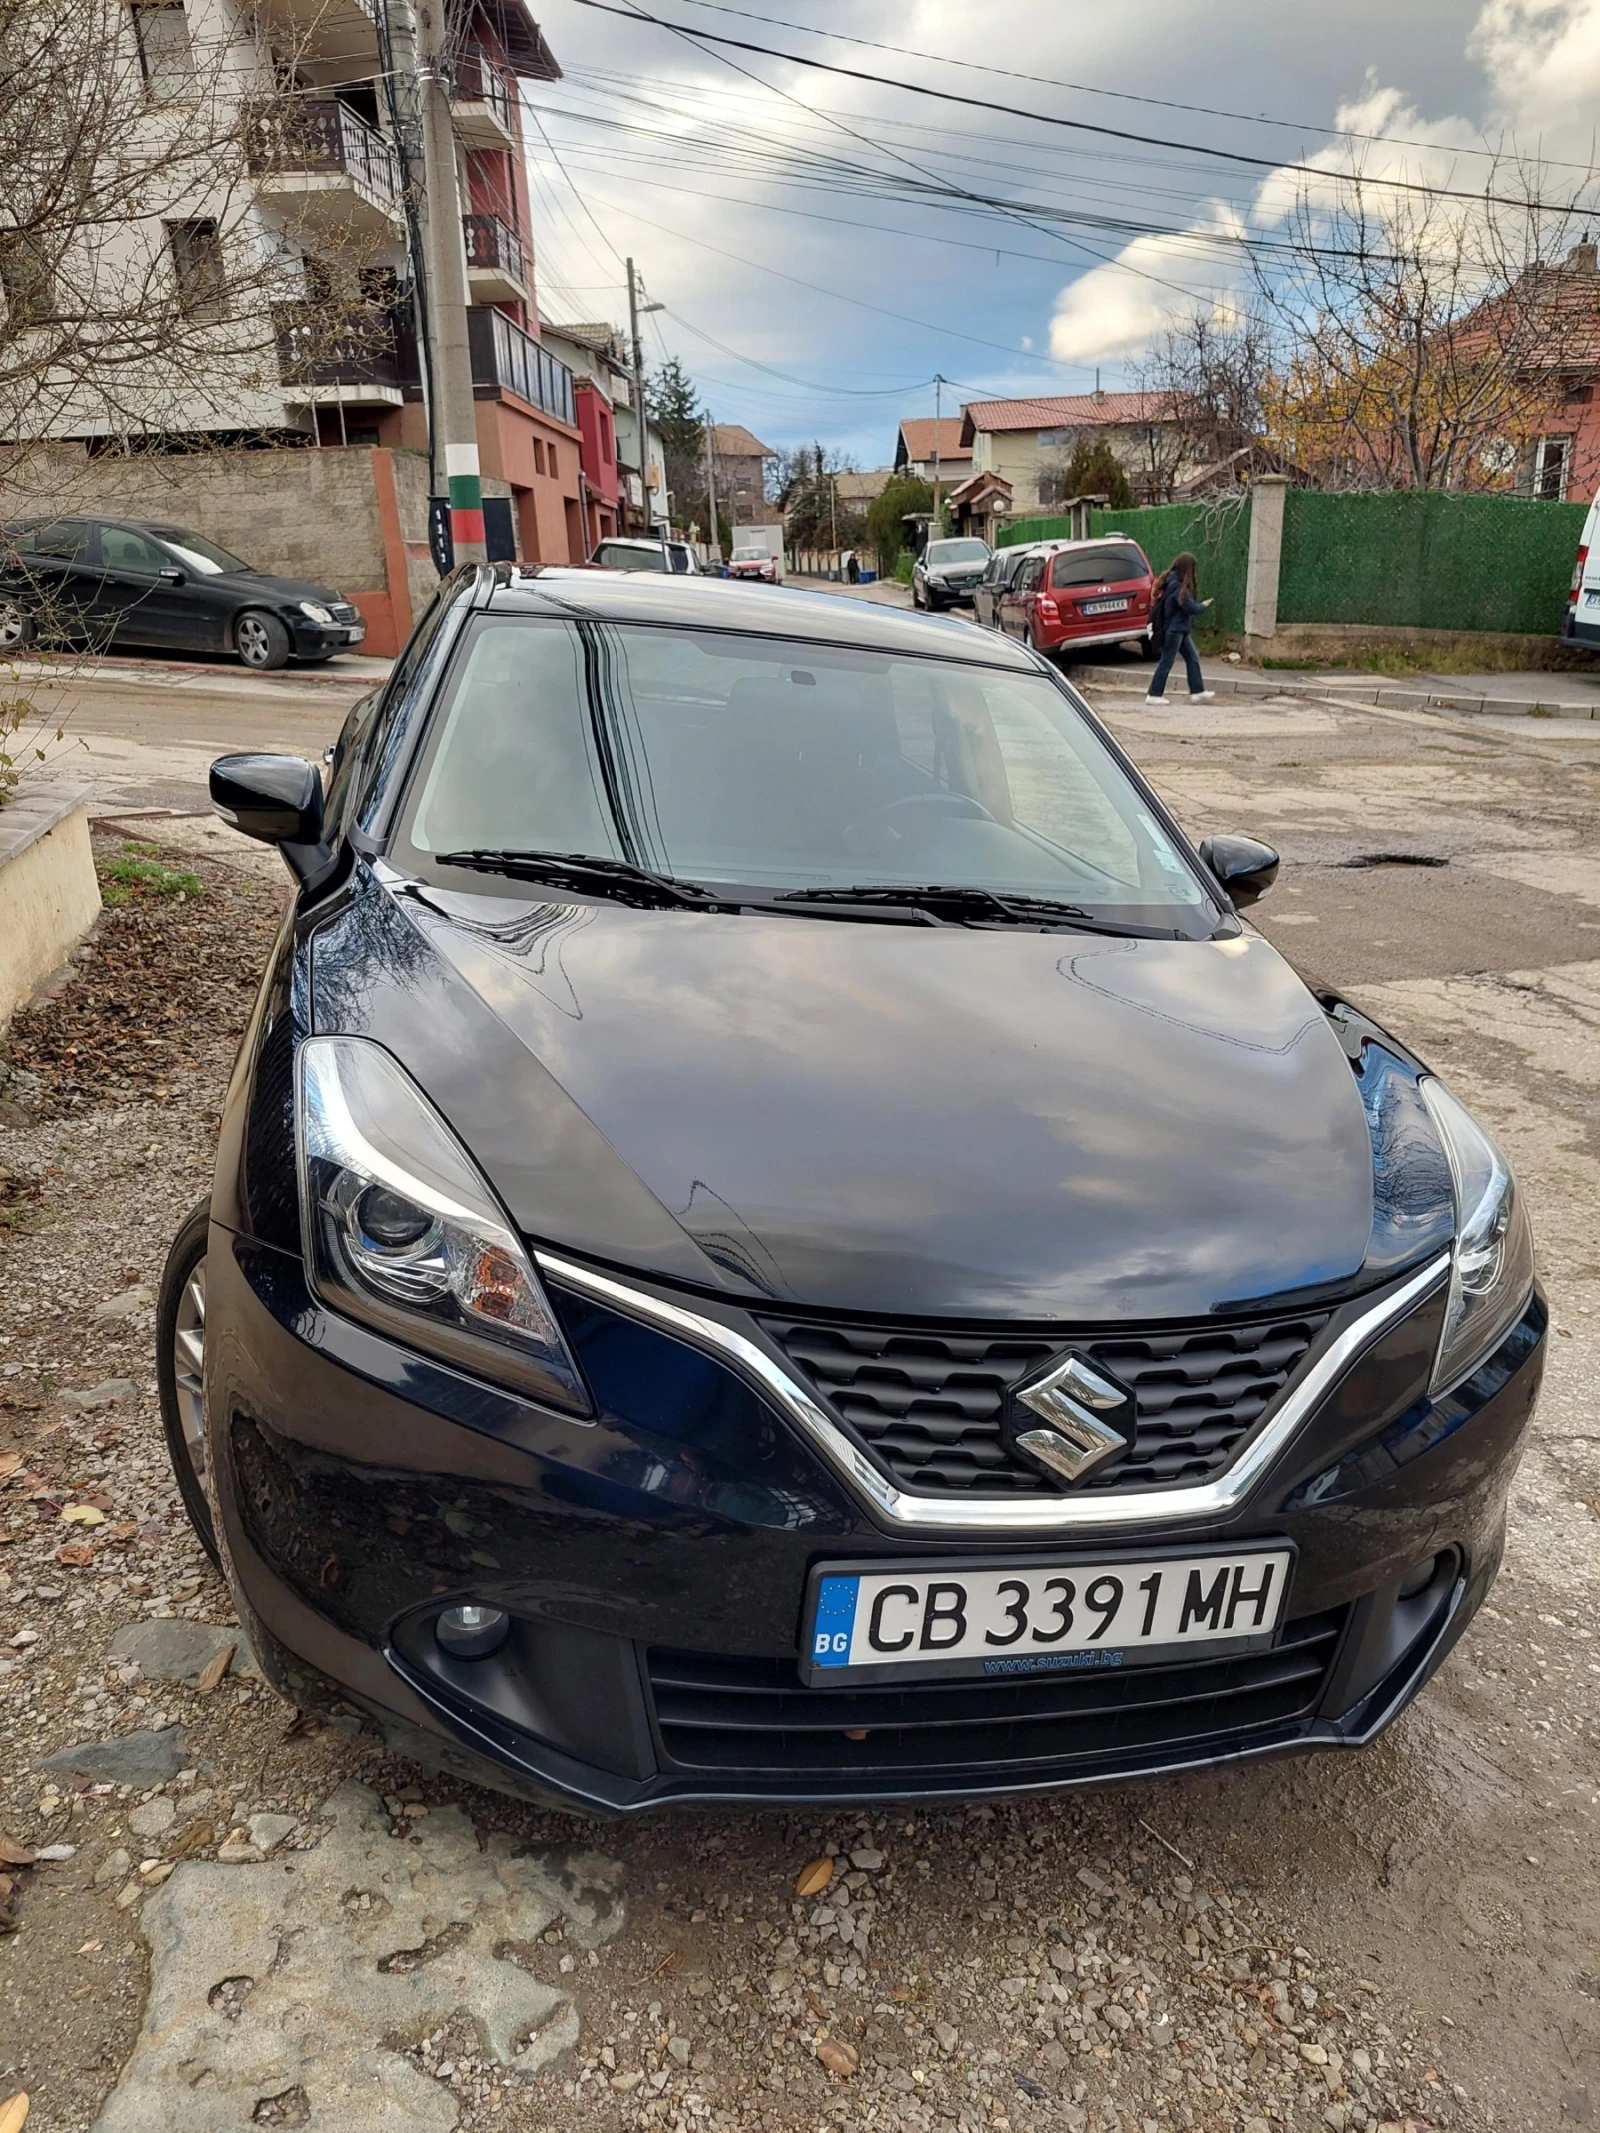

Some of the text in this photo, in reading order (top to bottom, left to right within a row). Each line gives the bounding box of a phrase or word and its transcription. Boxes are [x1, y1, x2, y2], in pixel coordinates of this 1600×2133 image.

[869, 1563, 1275, 1652] CB 3391 MH
[815, 1633, 847, 1653] BG
[984, 1650, 1123, 1673] www.suzuki.bg
